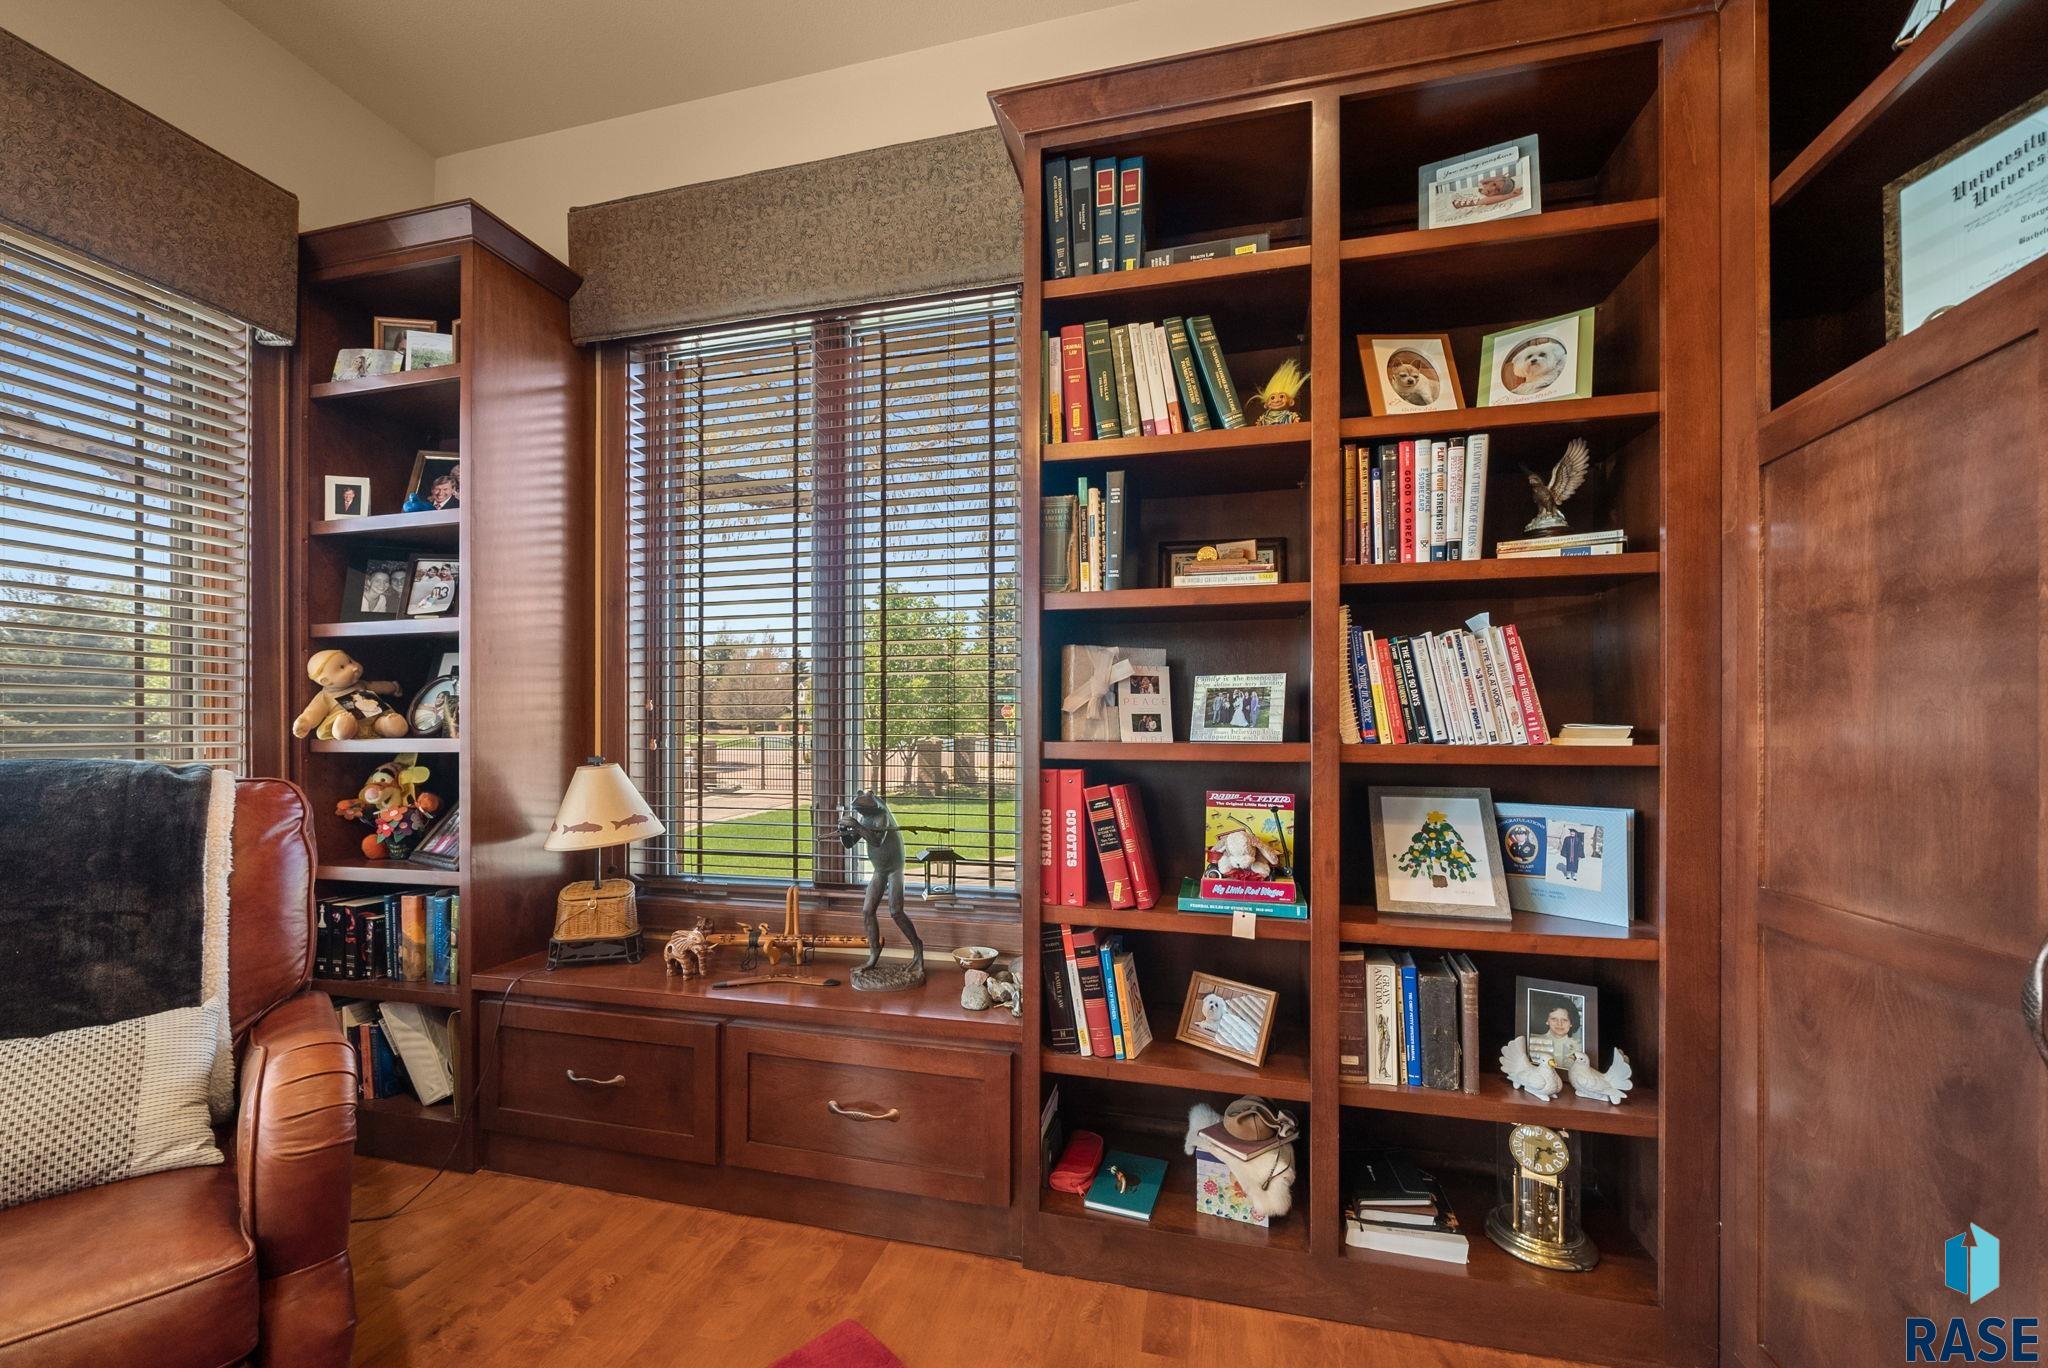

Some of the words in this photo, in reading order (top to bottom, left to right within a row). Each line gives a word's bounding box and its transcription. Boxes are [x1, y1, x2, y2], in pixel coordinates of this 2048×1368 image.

[1952, 131, 2048, 203] University
[1974, 151, 2048, 209] Univers
[1472, 443, 1482, 470] LEADING
[1437, 464, 1444, 473] TO
[1404, 470, 1412, 497] GOOD
[1436, 474, 1444, 492] YOUR
[1471, 481, 1479, 493] THE
[1405, 501, 1412, 514] TO
[1436, 492, 1444, 530] STRENGTHS
[1470, 495, 1478, 512] EDGE
[1468, 515, 1477, 523] OF
[1404, 520, 1412, 550] GREAT
[1467, 525, 1476, 546] CHAOS
[1511, 646, 1519, 661] SIGMA
[1404, 660, 1414, 677] FIRST
[1482, 647, 1490, 661] TYPE
[1489, 678, 1495, 686] AT
[1492, 688, 1501, 707] WORK
[1515, 662, 1523, 672] WAY
[1408, 678, 1416, 687] 90
[1455, 634, 1465, 660] WORKING
[1464, 679, 1475, 705] DIFFICULT
[1472, 708, 1481, 729] PEOPLE
[1517, 674, 1526, 686] TEAM
[1123, 697, 1168, 706] PEACE
[1356, 663, 1368, 688] Serving
[1362, 698, 1371, 722] Silence
[1411, 689, 1420, 705] DAYS
[1522, 688, 1533, 713] FIELDBOOK
[1256, 795, 1291, 803] FLYER
[1041, 808, 1052, 867] COYOTES
[1065, 809, 1078, 867] COYOTES
[1212, 884, 1225, 895] My
[1225, 885, 1244, 895] Little
[1244, 886, 1260, 895] Red
[1260, 886, 1285, 898] Wagon
[1054, 971, 1062, 995] FAMILY
[1374, 967, 1384, 1011] ANATOMY
[1382, 974, 1391, 1005] GRAY'S
